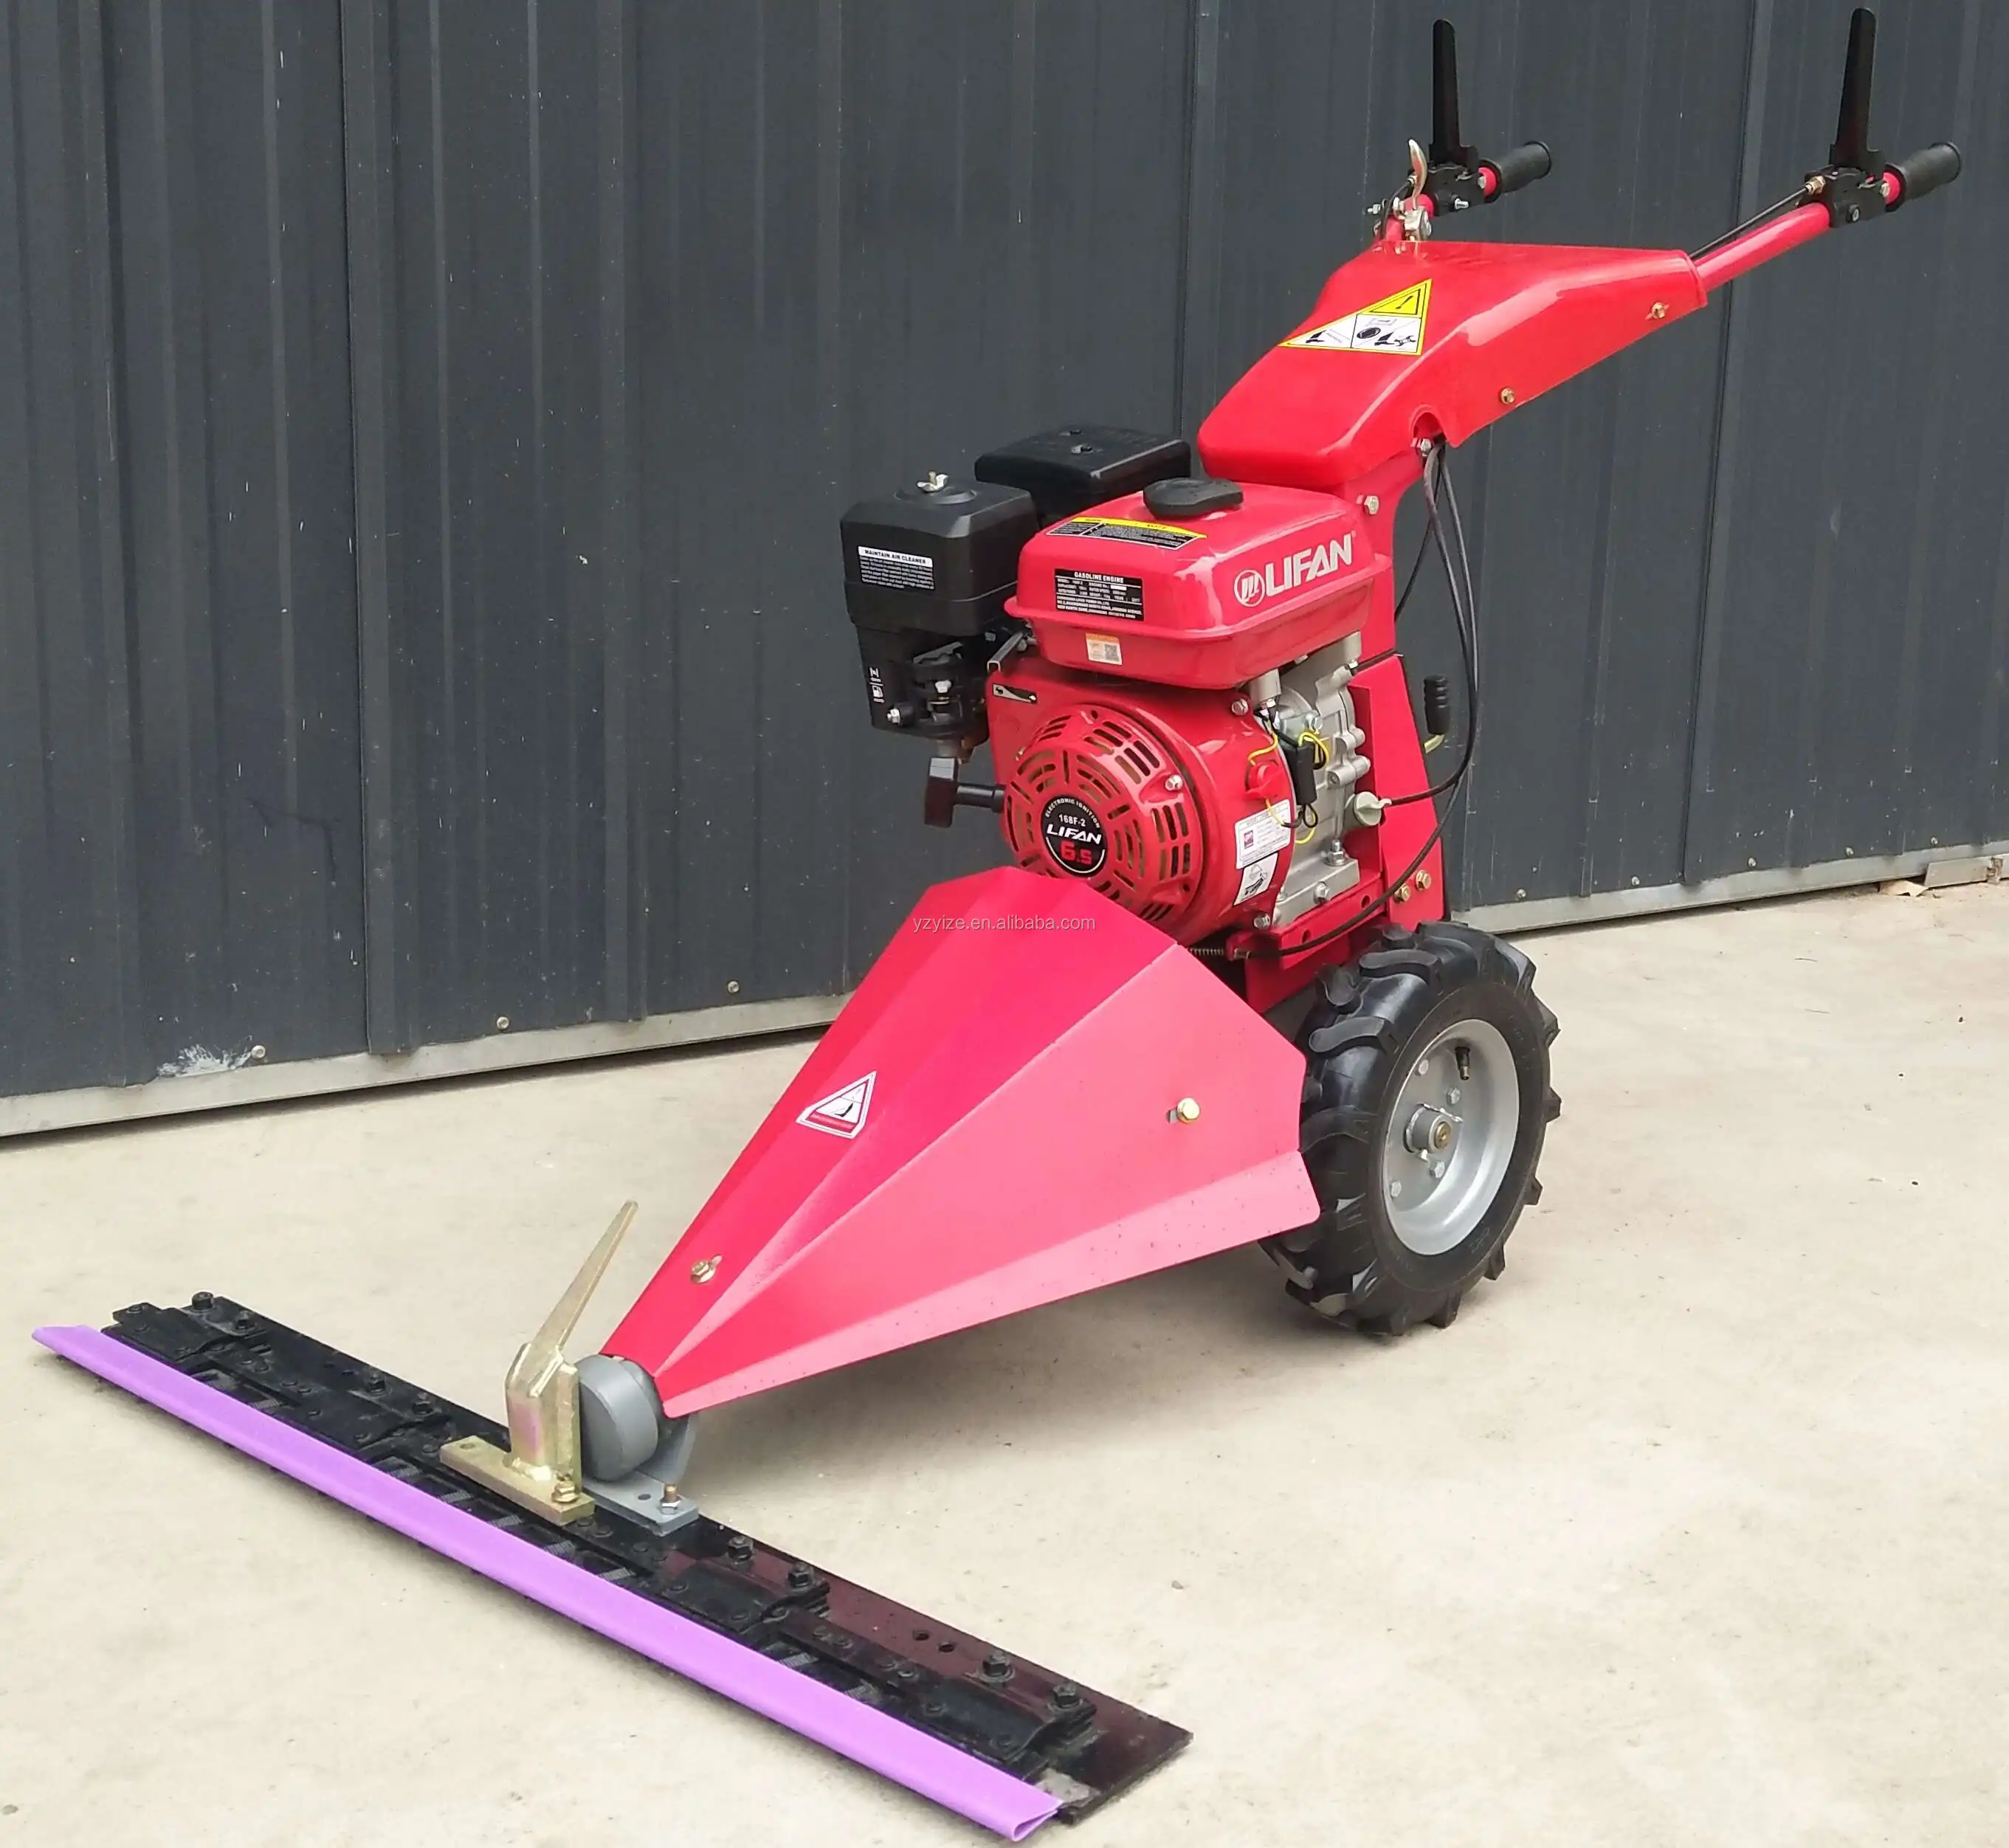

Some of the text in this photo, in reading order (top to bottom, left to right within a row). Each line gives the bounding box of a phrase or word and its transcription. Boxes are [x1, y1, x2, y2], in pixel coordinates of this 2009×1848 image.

[864, 549, 890, 559] MAINTAIN
[901, 556, 926, 564] CLEANER
[1265, 533, 1352, 597] LIFAN
[1074, 571, 1124, 583] GASOLINE ENGINE
[1045, 798, 1100, 828] ELECTRONIC IGNITION
[1058, 813, 1086, 827] 168F-2
[1047, 824, 1102, 845] LIFAN
[1060, 840, 1092, 865] 6.5
